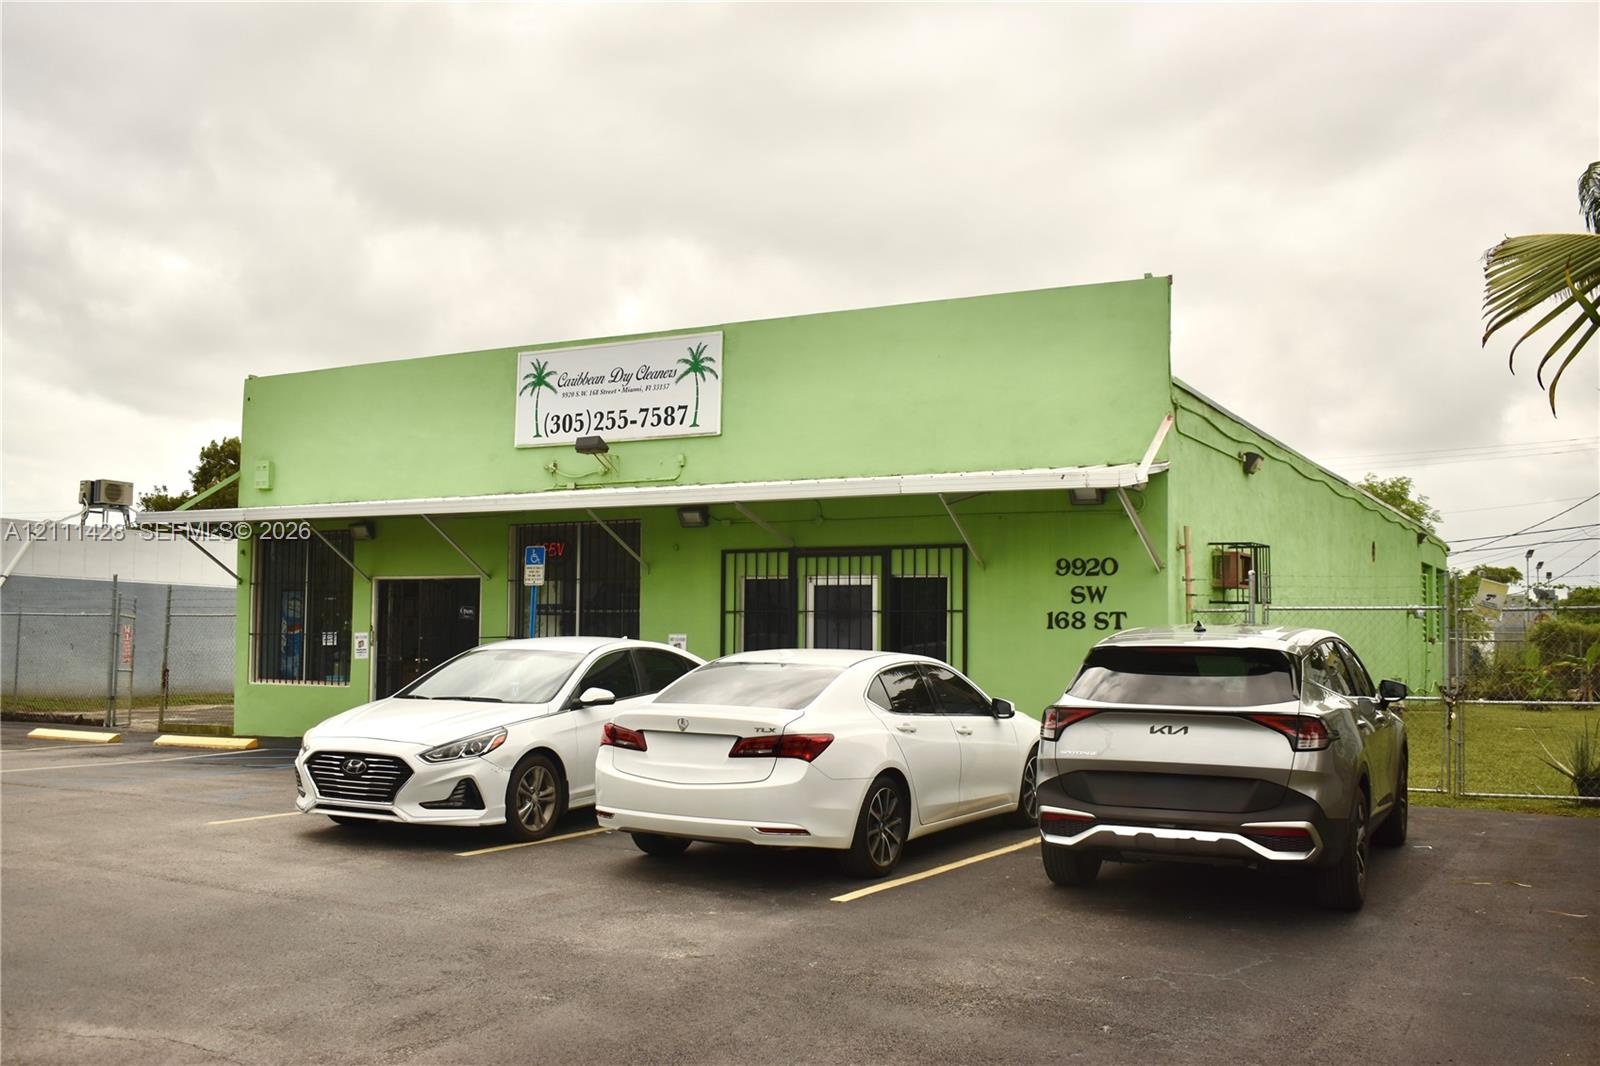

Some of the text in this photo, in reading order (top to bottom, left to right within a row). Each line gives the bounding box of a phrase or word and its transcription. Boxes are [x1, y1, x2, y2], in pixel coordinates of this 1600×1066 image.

[557, 364, 678, 388] Caribbean Dry Cleaners
[561, 391, 575, 399] 9920
[652, 383, 670, 391] 33157
[544, 405, 688, 437] (305)255-7587
[1056, 557, 1119, 576] 9920
[1070, 585, 1107, 604] SW
[1047, 611, 1127, 630] 168 ST
[1150, 725, 1188, 735] KIA
